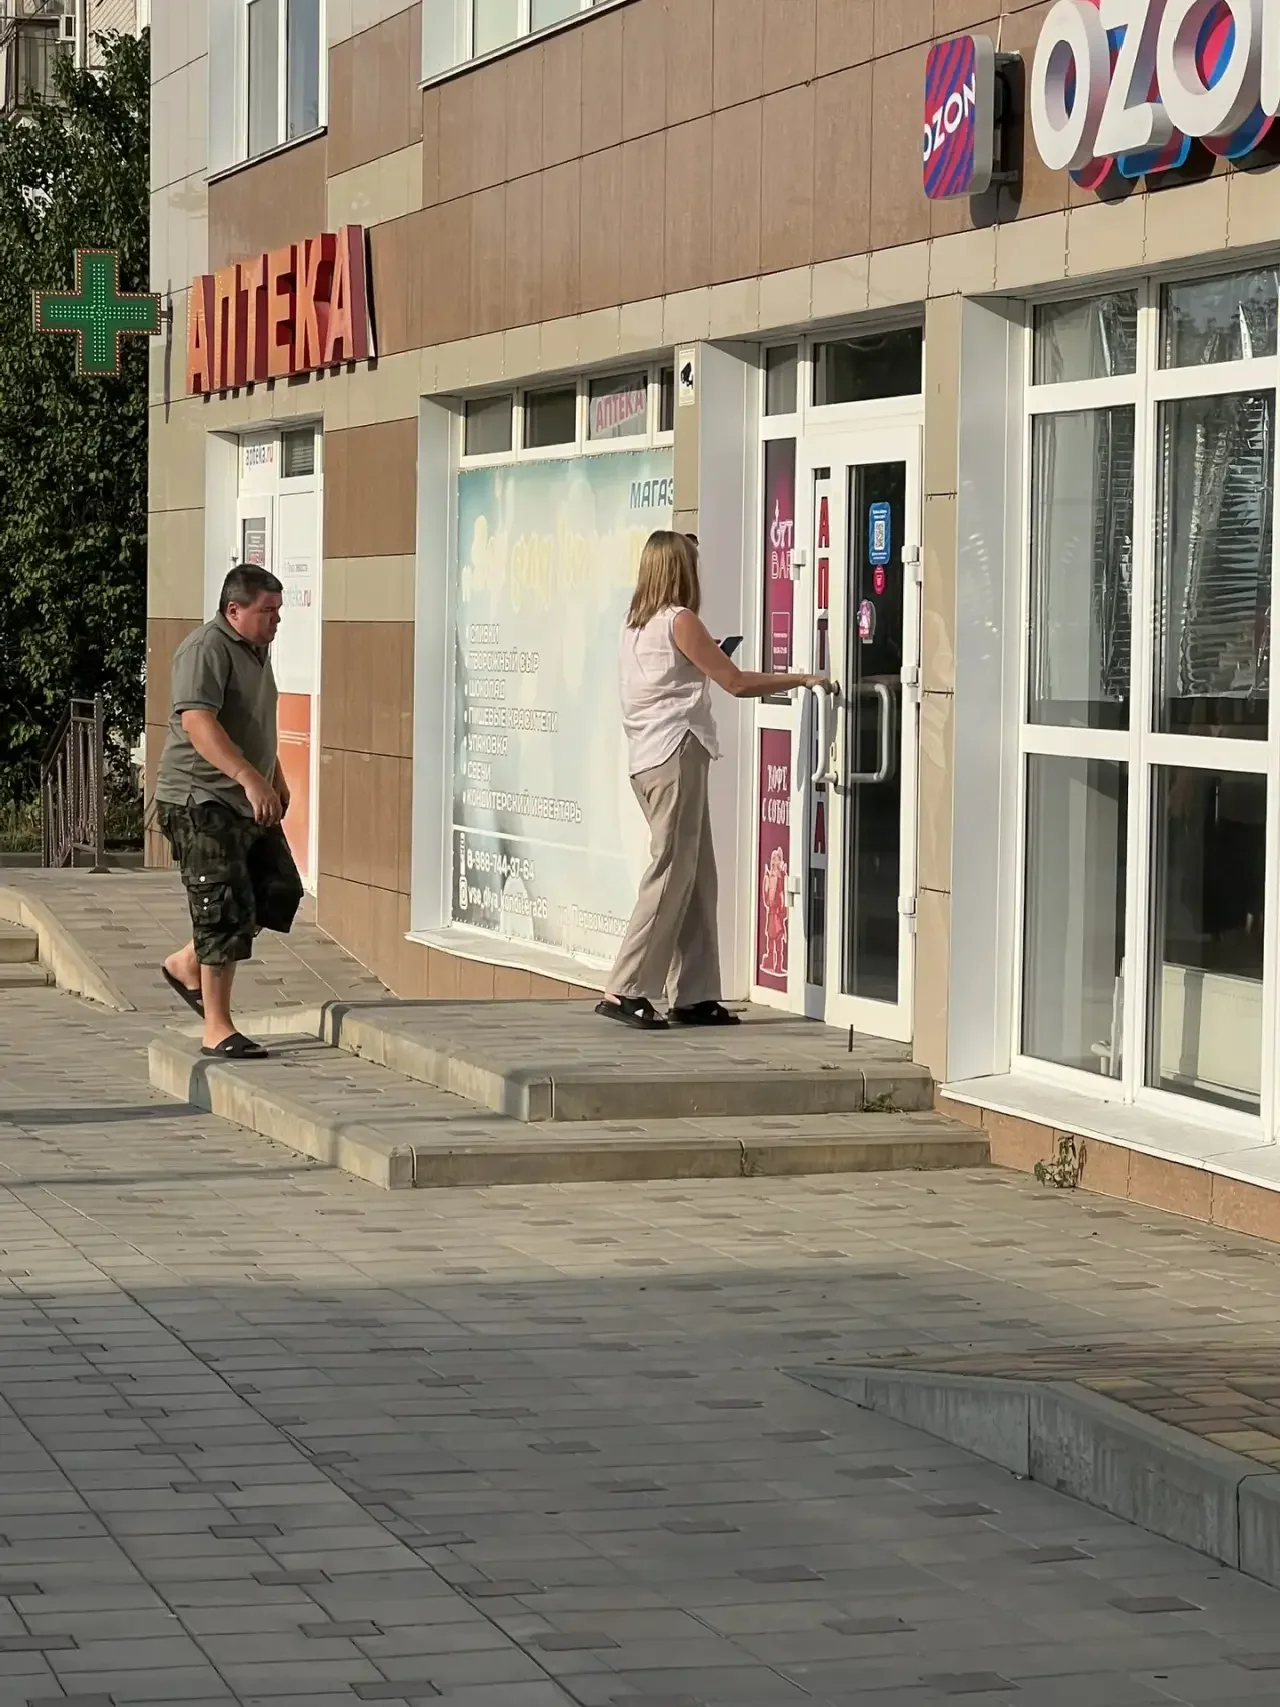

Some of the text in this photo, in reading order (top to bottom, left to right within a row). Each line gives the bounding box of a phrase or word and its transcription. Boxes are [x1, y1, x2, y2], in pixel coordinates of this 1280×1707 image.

[185, 224, 368, 395] АПТЕКА
[596, 386, 643, 433] АПТЕКА
[468, 646, 540, 674] ТВОРОЖНЫЙ СЫР
[468, 678, 506, 701] ШОКОЛАД
[508, 707, 559, 733] КРАСИТЕЛИ
[467, 732, 508, 757] УПАКОВКА
[467, 759, 492, 782] СВЕЧИ
[466, 787, 582, 824] КОНДИТЕРСКИЙ ИНВЕНТАРЬ
